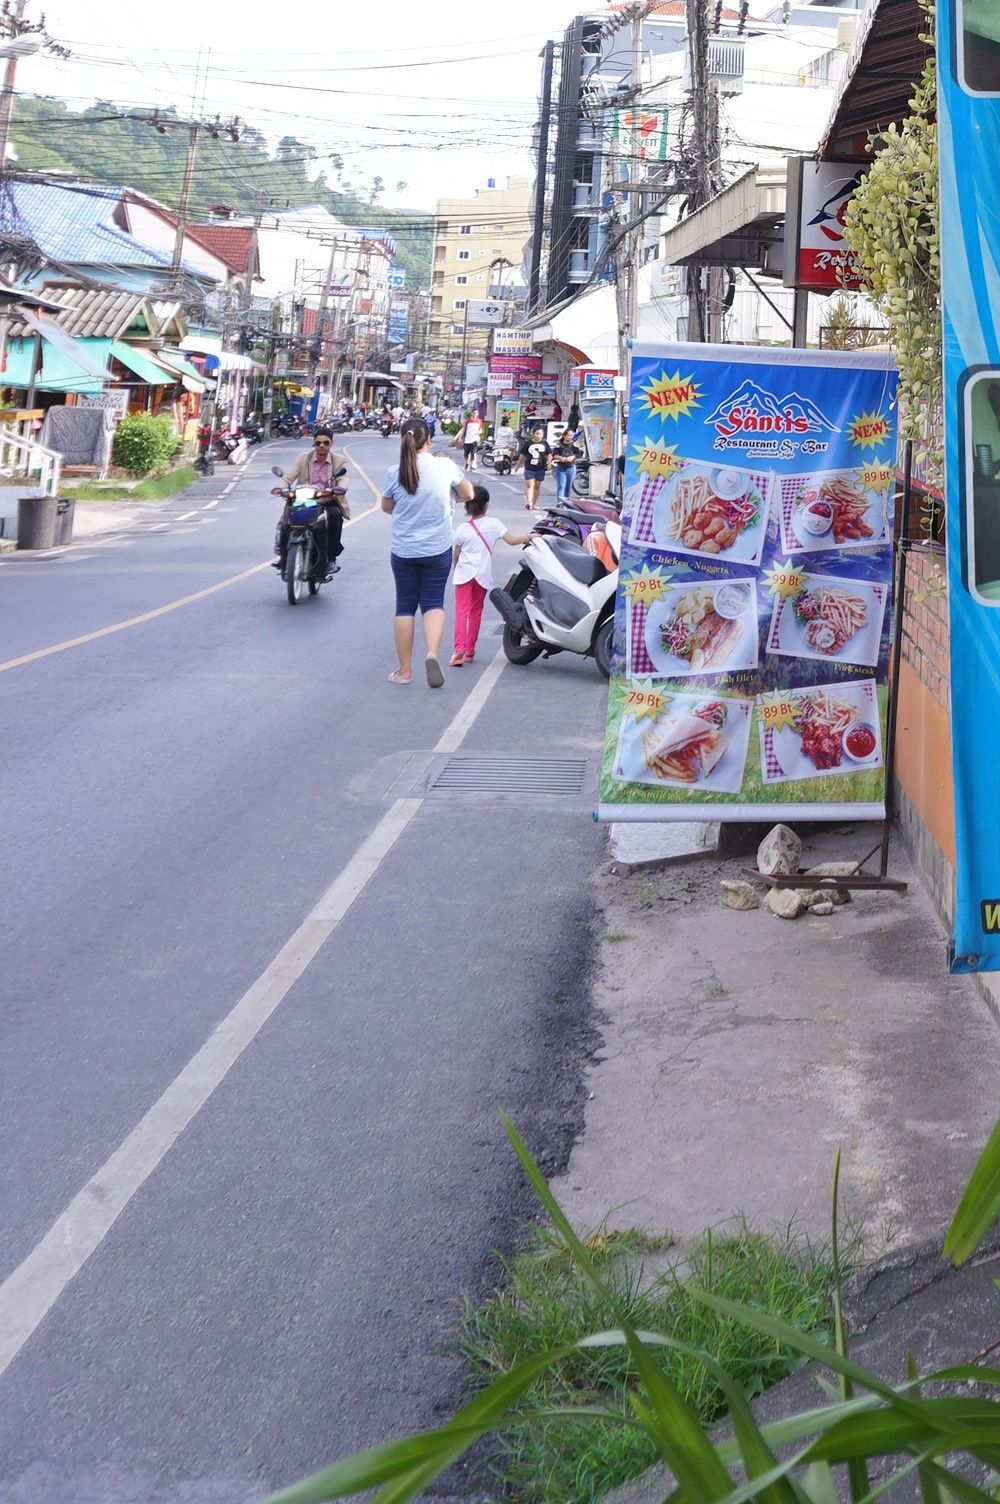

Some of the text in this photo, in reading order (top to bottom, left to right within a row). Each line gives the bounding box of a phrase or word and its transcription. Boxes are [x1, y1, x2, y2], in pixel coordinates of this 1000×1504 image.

[648, 383, 697, 409] NEW!
[715, 406, 812, 436] Säntis
[852, 420, 888, 440] NEW!
[714, 437, 777, 450] Restaurant
[802, 439, 828, 453] Bar
[642, 450, 673, 466] 79 Bt
[864, 471, 890, 483] 89 Bt
[632, 578, 662, 593] 79 Bt
[772, 574, 799, 586] 99 Bt
[628, 691, 660, 709] 79 Bt
[763, 703, 792, 719] 89 Bt
